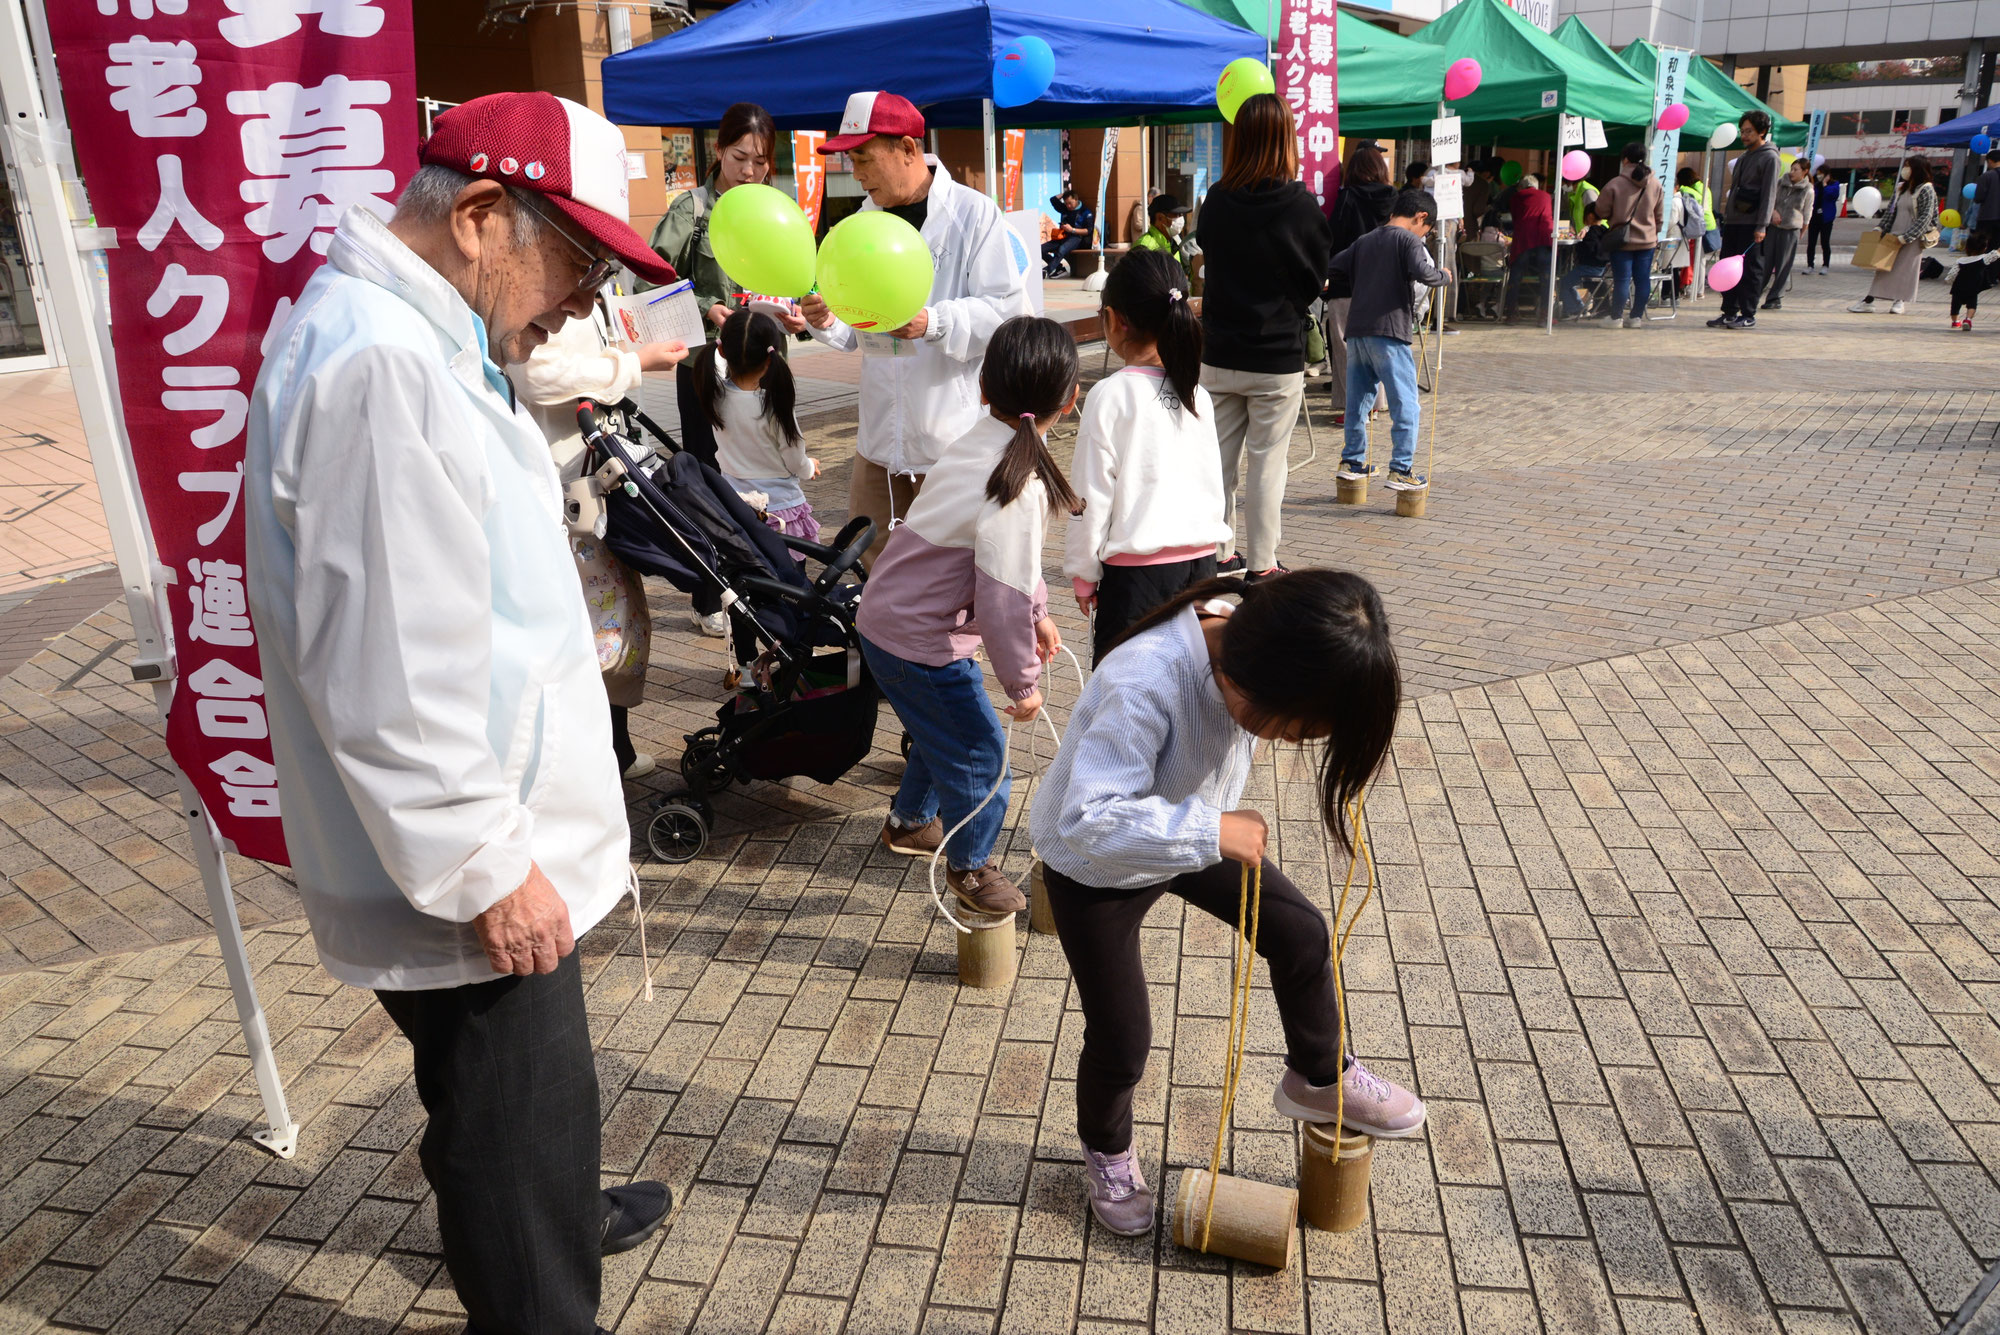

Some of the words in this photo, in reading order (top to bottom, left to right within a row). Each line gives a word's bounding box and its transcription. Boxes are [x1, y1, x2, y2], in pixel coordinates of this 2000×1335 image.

[97, 0, 282, 817] 老人クラブ連合会
